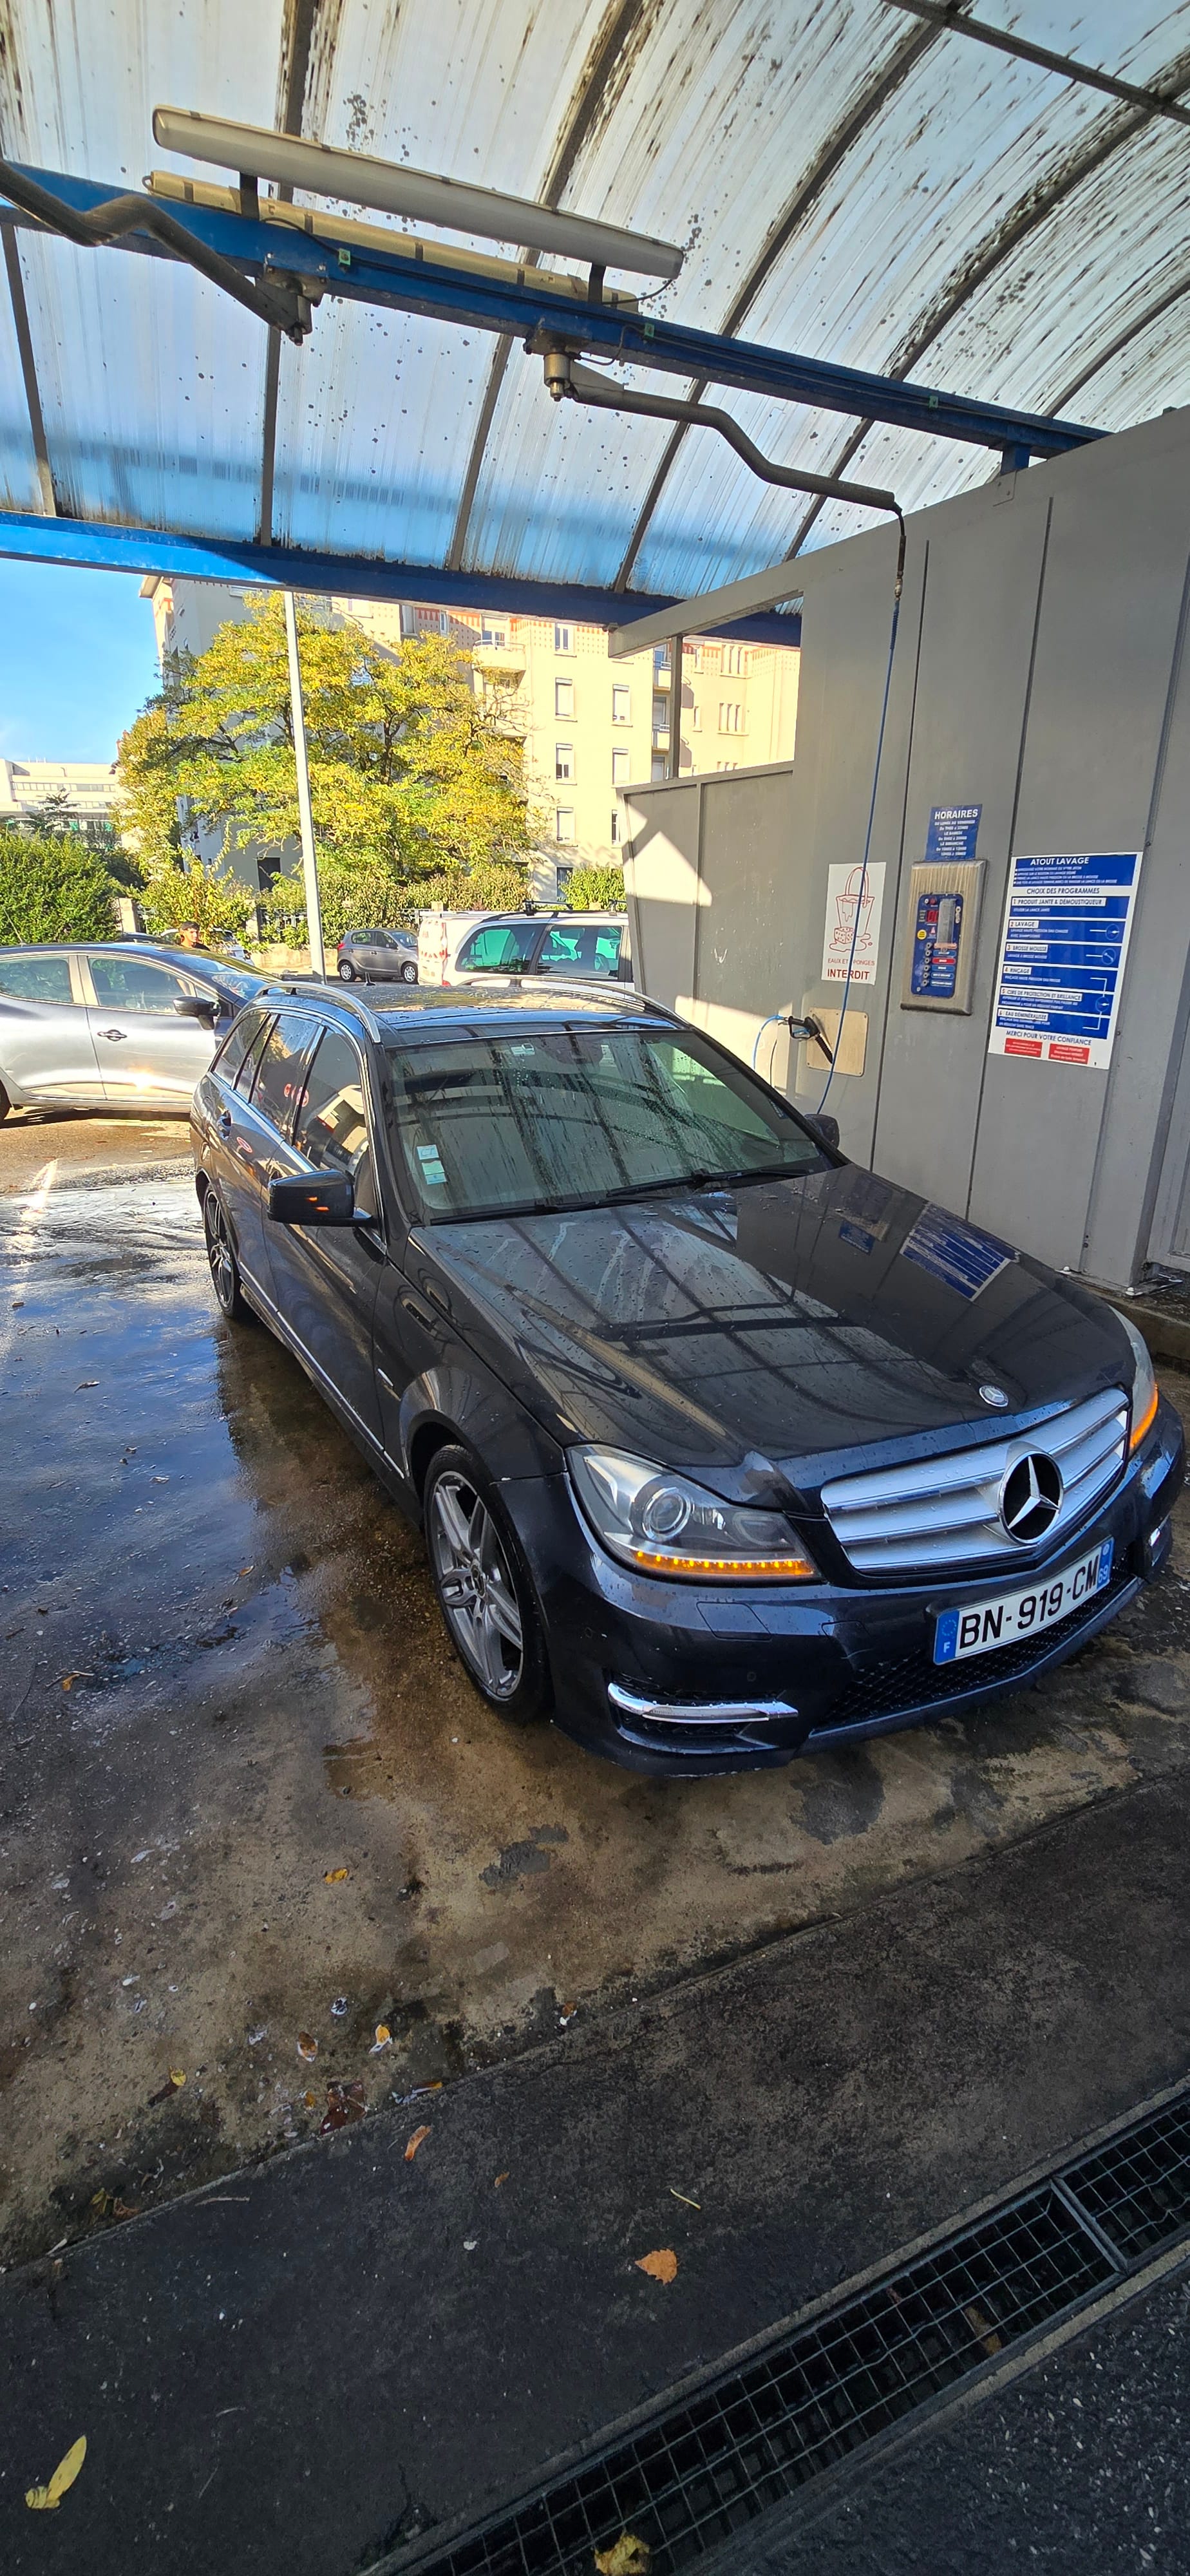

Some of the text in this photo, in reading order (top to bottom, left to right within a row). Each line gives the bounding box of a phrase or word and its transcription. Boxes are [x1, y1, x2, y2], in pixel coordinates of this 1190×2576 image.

[934, 809, 978, 820] HORAIRES
[827, 969, 870, 980] INTERDIT
[1057, 1036, 1092, 1046] CONFIANCE
[943, 1642, 950, 1653] F
[1099, 1565, 1109, 1584] 69
